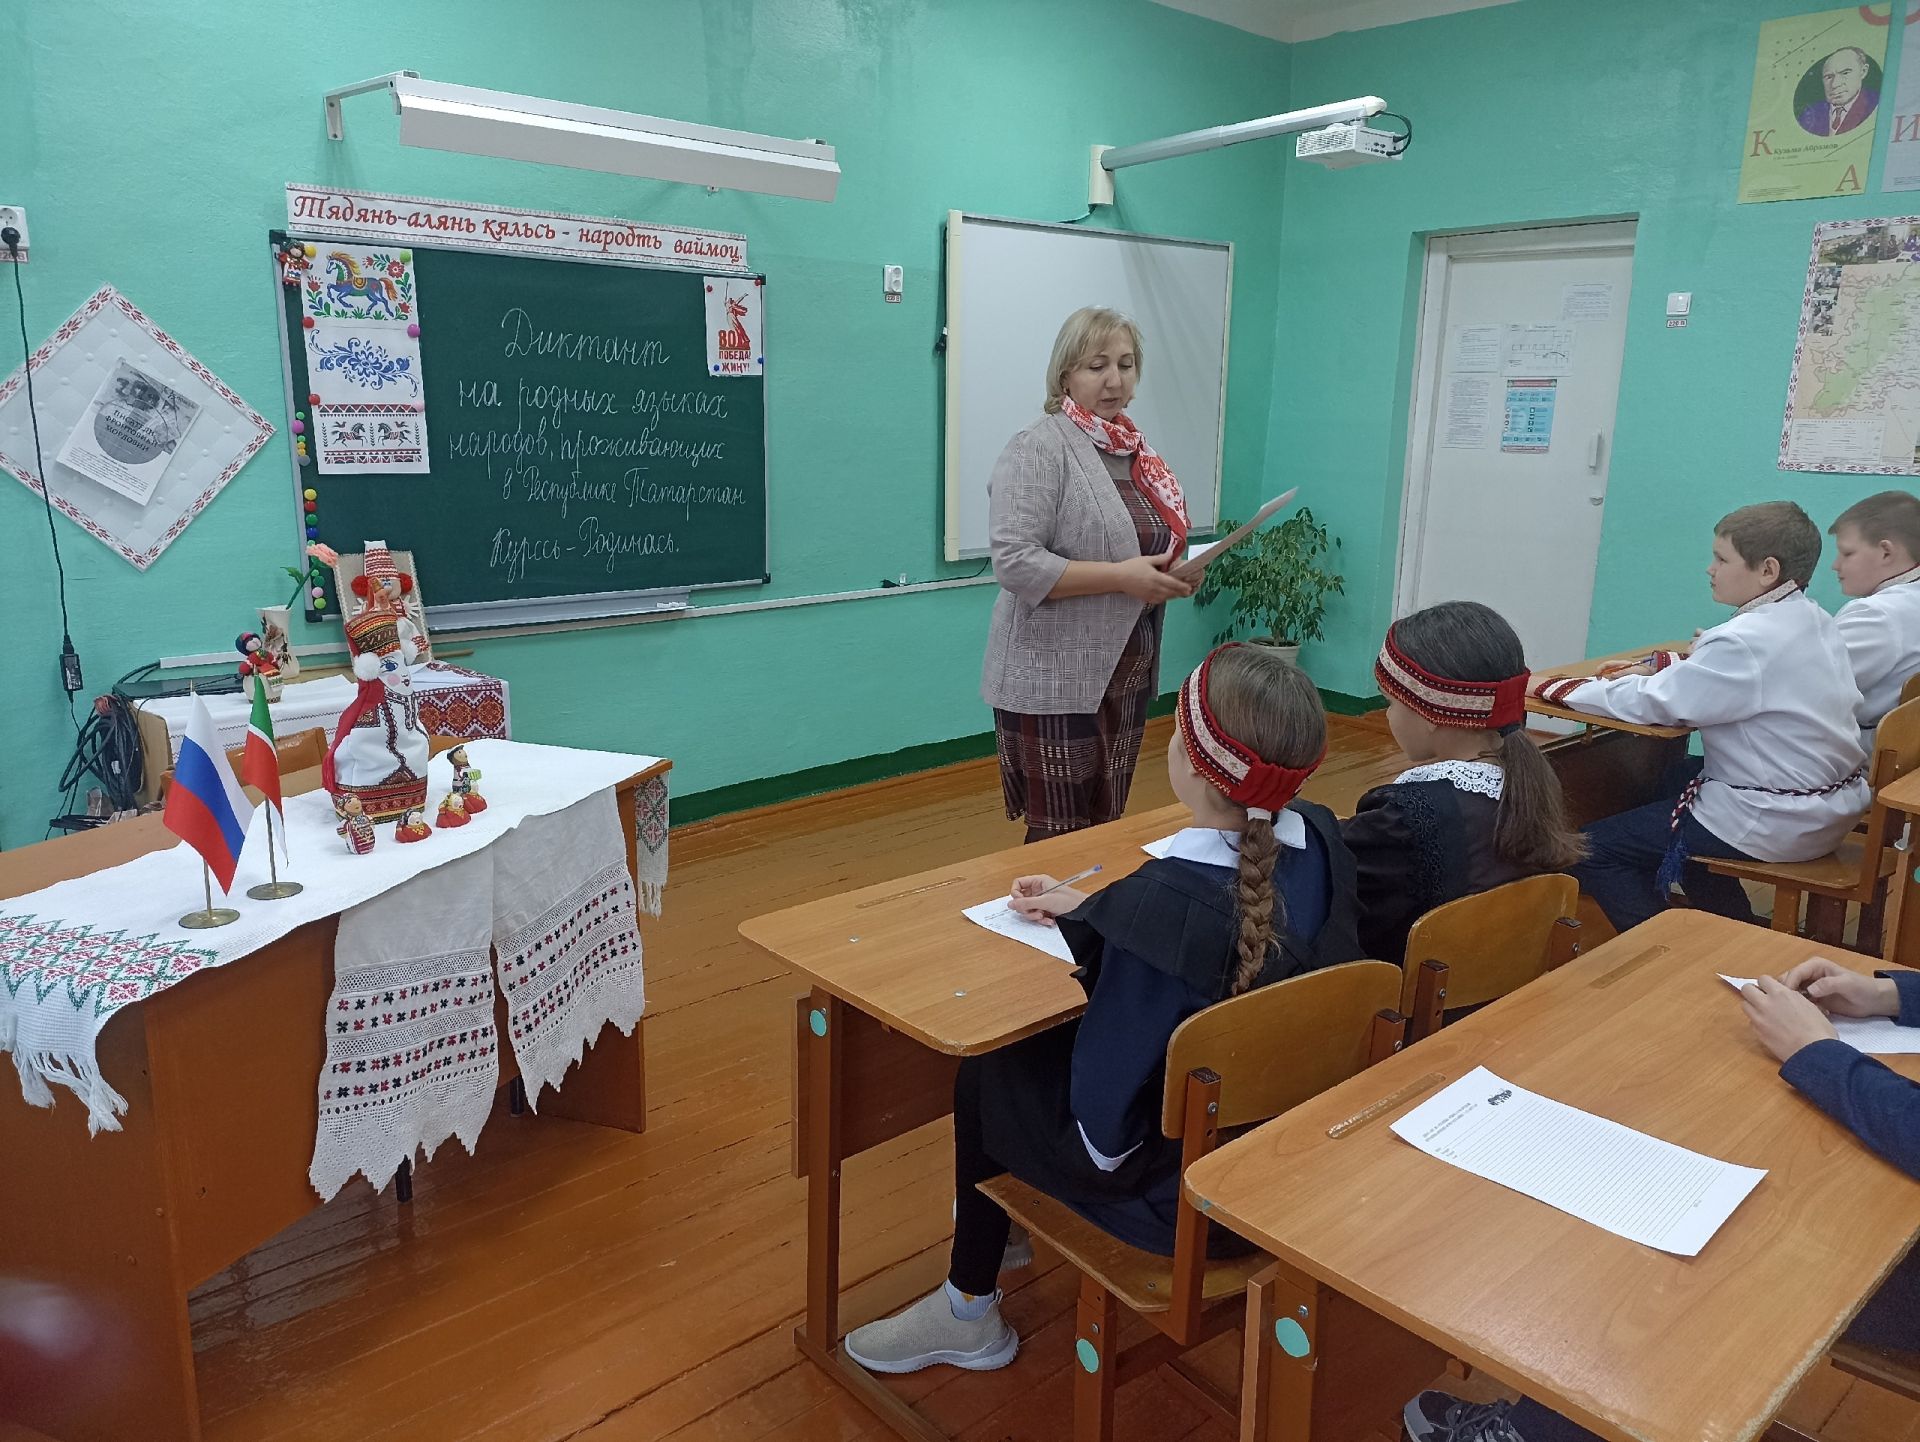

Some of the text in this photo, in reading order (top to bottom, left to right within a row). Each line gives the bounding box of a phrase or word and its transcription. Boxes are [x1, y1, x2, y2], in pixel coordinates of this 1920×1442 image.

[1835, 164, 1862, 192] А
[294, 196, 476, 234] Тядянь-алянь
[578, 225, 663, 252] народть
[501, 307, 671, 367] Диктант
[718, 350, 752, 361] ПОБЕДА!
[459, 377, 728, 431] на родных языках
[105, 424, 150, 452] МОРДОВИИ
[561, 427, 726, 479] проживающих
[502, 465, 746, 522] в Республике Татарстан
